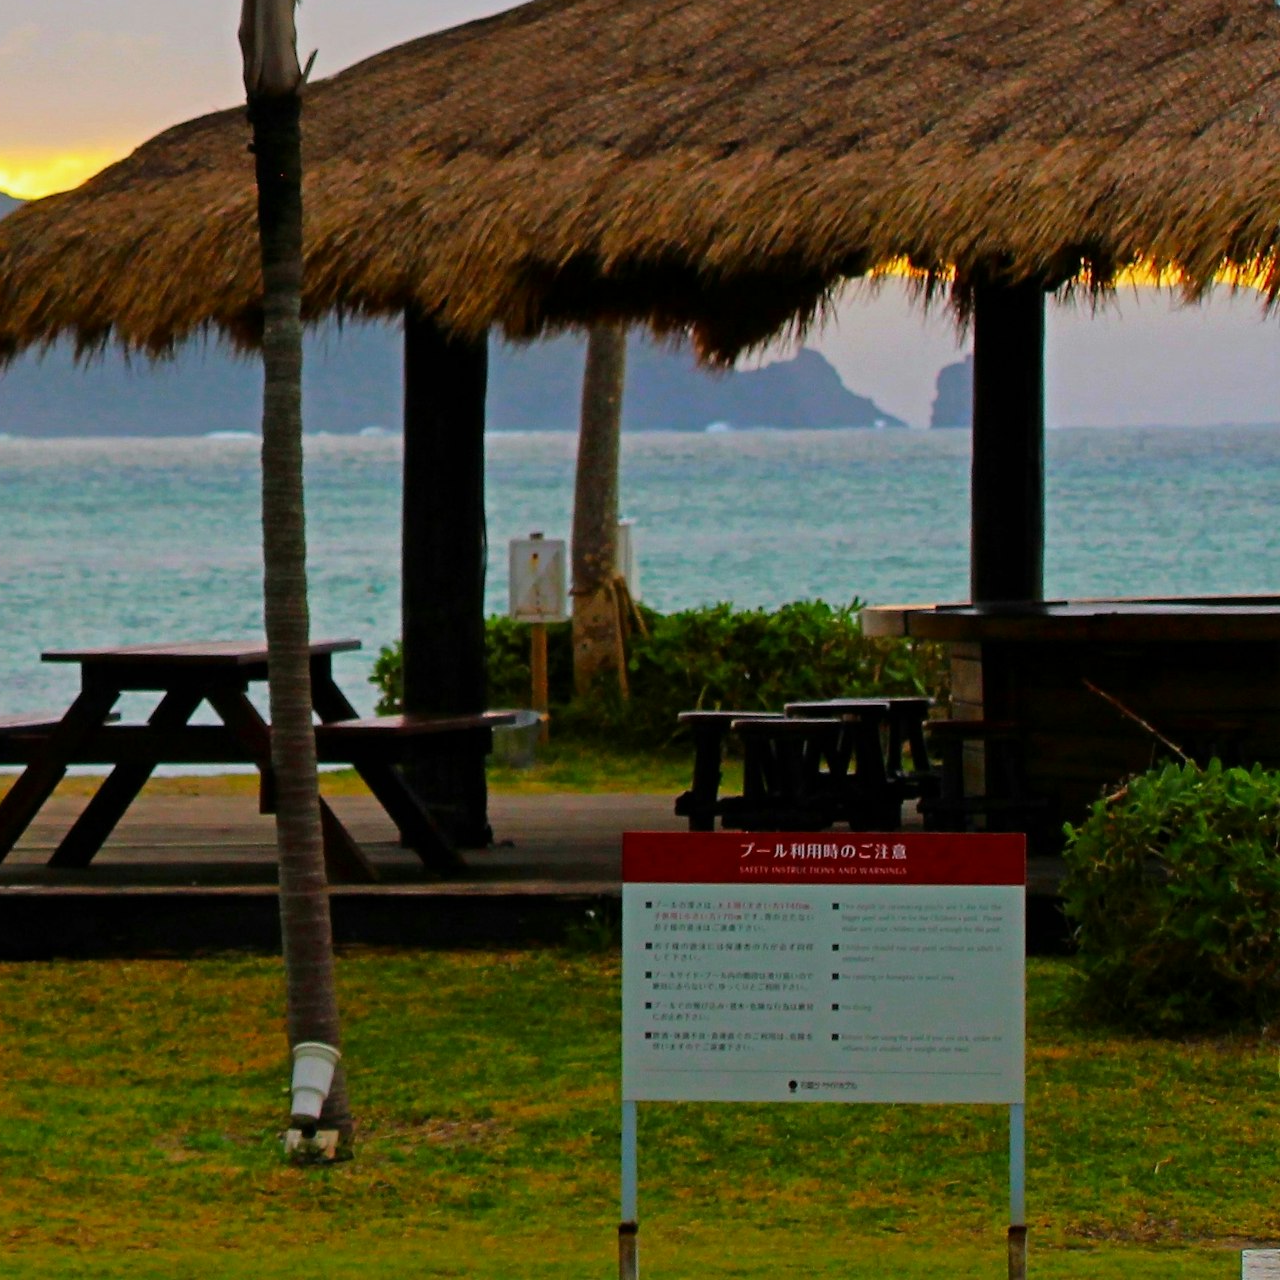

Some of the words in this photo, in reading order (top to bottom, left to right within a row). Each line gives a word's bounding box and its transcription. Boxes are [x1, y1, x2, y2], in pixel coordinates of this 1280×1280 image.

[739, 842, 908, 860] プール利用時のご注意
[739, 865, 769, 874] SAFETY
[772, 865, 835, 875] INSTRUCTIONS
[838, 866, 857, 875] AND
[860, 866, 908, 876] WARNINGS
